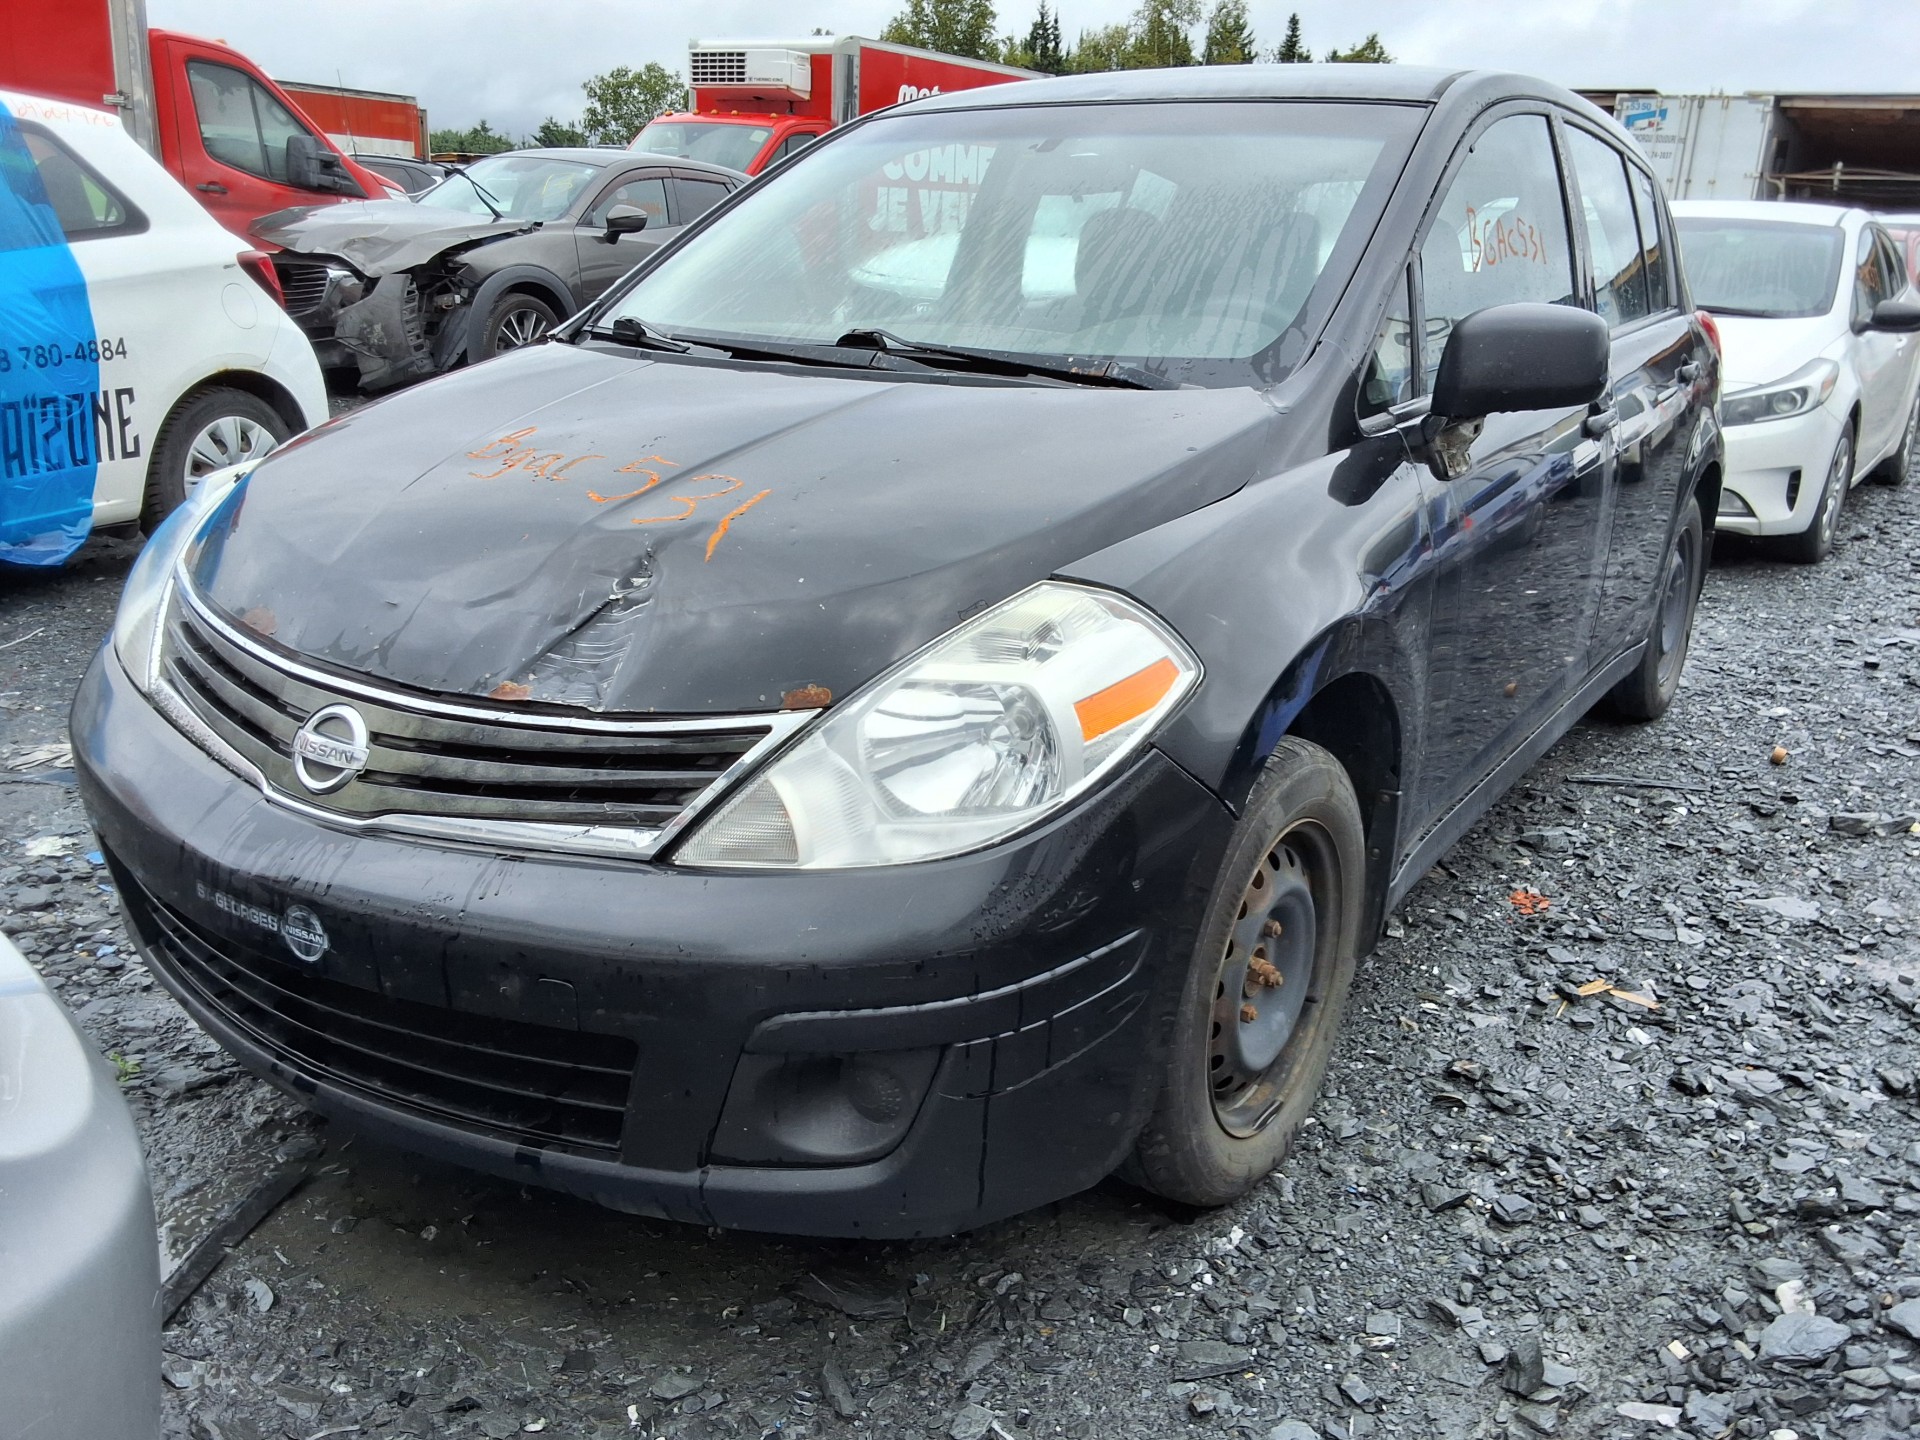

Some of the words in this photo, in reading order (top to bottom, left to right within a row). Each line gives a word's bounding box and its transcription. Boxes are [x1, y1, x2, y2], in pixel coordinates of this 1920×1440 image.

[867, 186, 909, 232] JE
[18, 337, 128, 370] 780-4884
[296, 734, 355, 765] NISSAN
[285, 924, 324, 944] NISSAN
